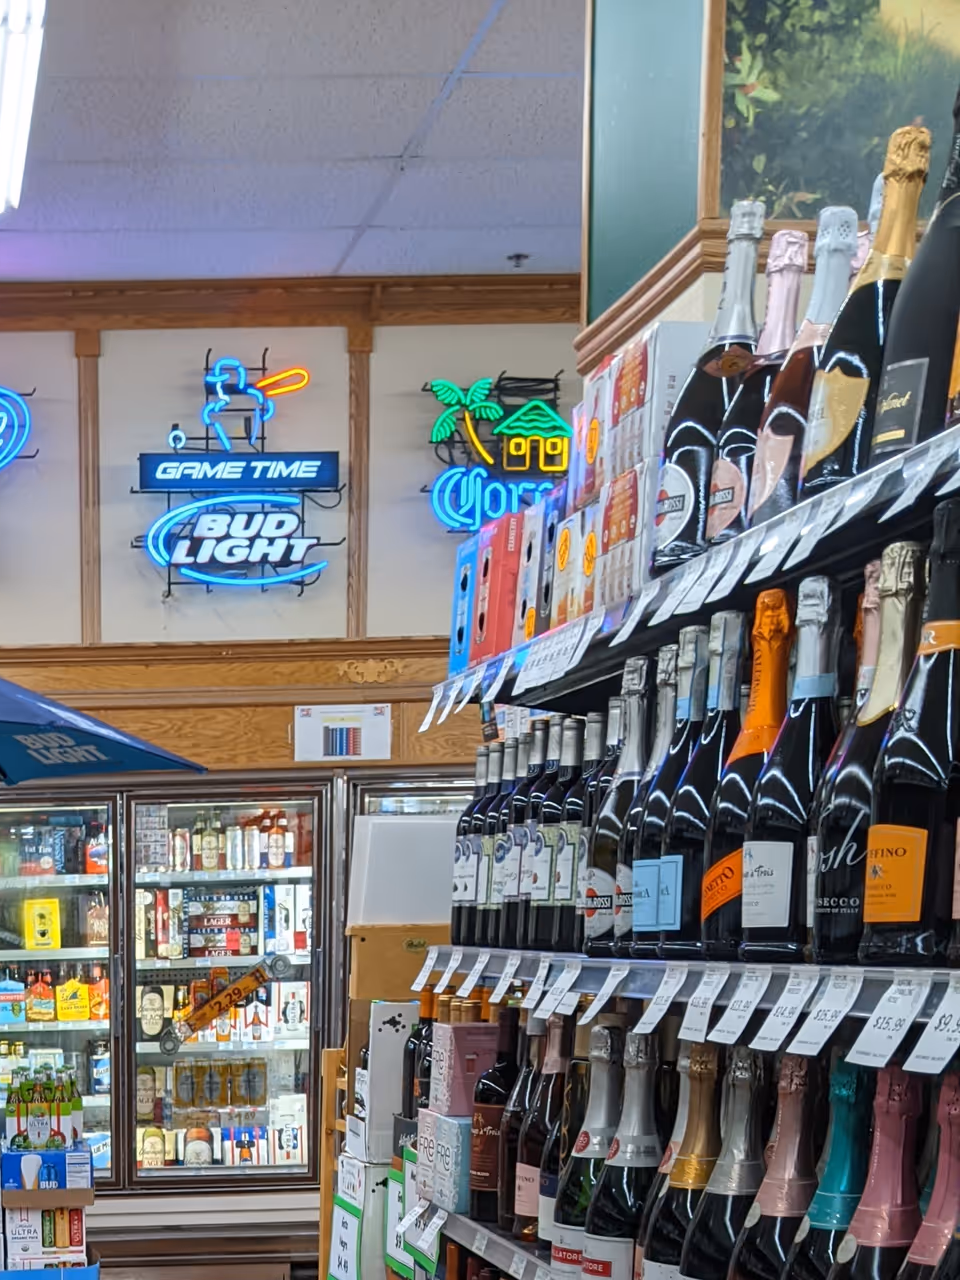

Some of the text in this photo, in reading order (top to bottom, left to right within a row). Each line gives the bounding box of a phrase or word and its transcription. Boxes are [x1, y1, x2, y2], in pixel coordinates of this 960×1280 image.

[155, 460, 322, 479] GAME TIME
[193, 513, 301, 538] BUD
[170, 538, 318, 564] LIGHT
[204, 917, 232, 925] LAGER
[872, 1016, 906, 1032] $15.99
[40, 1181, 59, 1189] BUD
[11, 1228, 39, 1236] ULTRA
